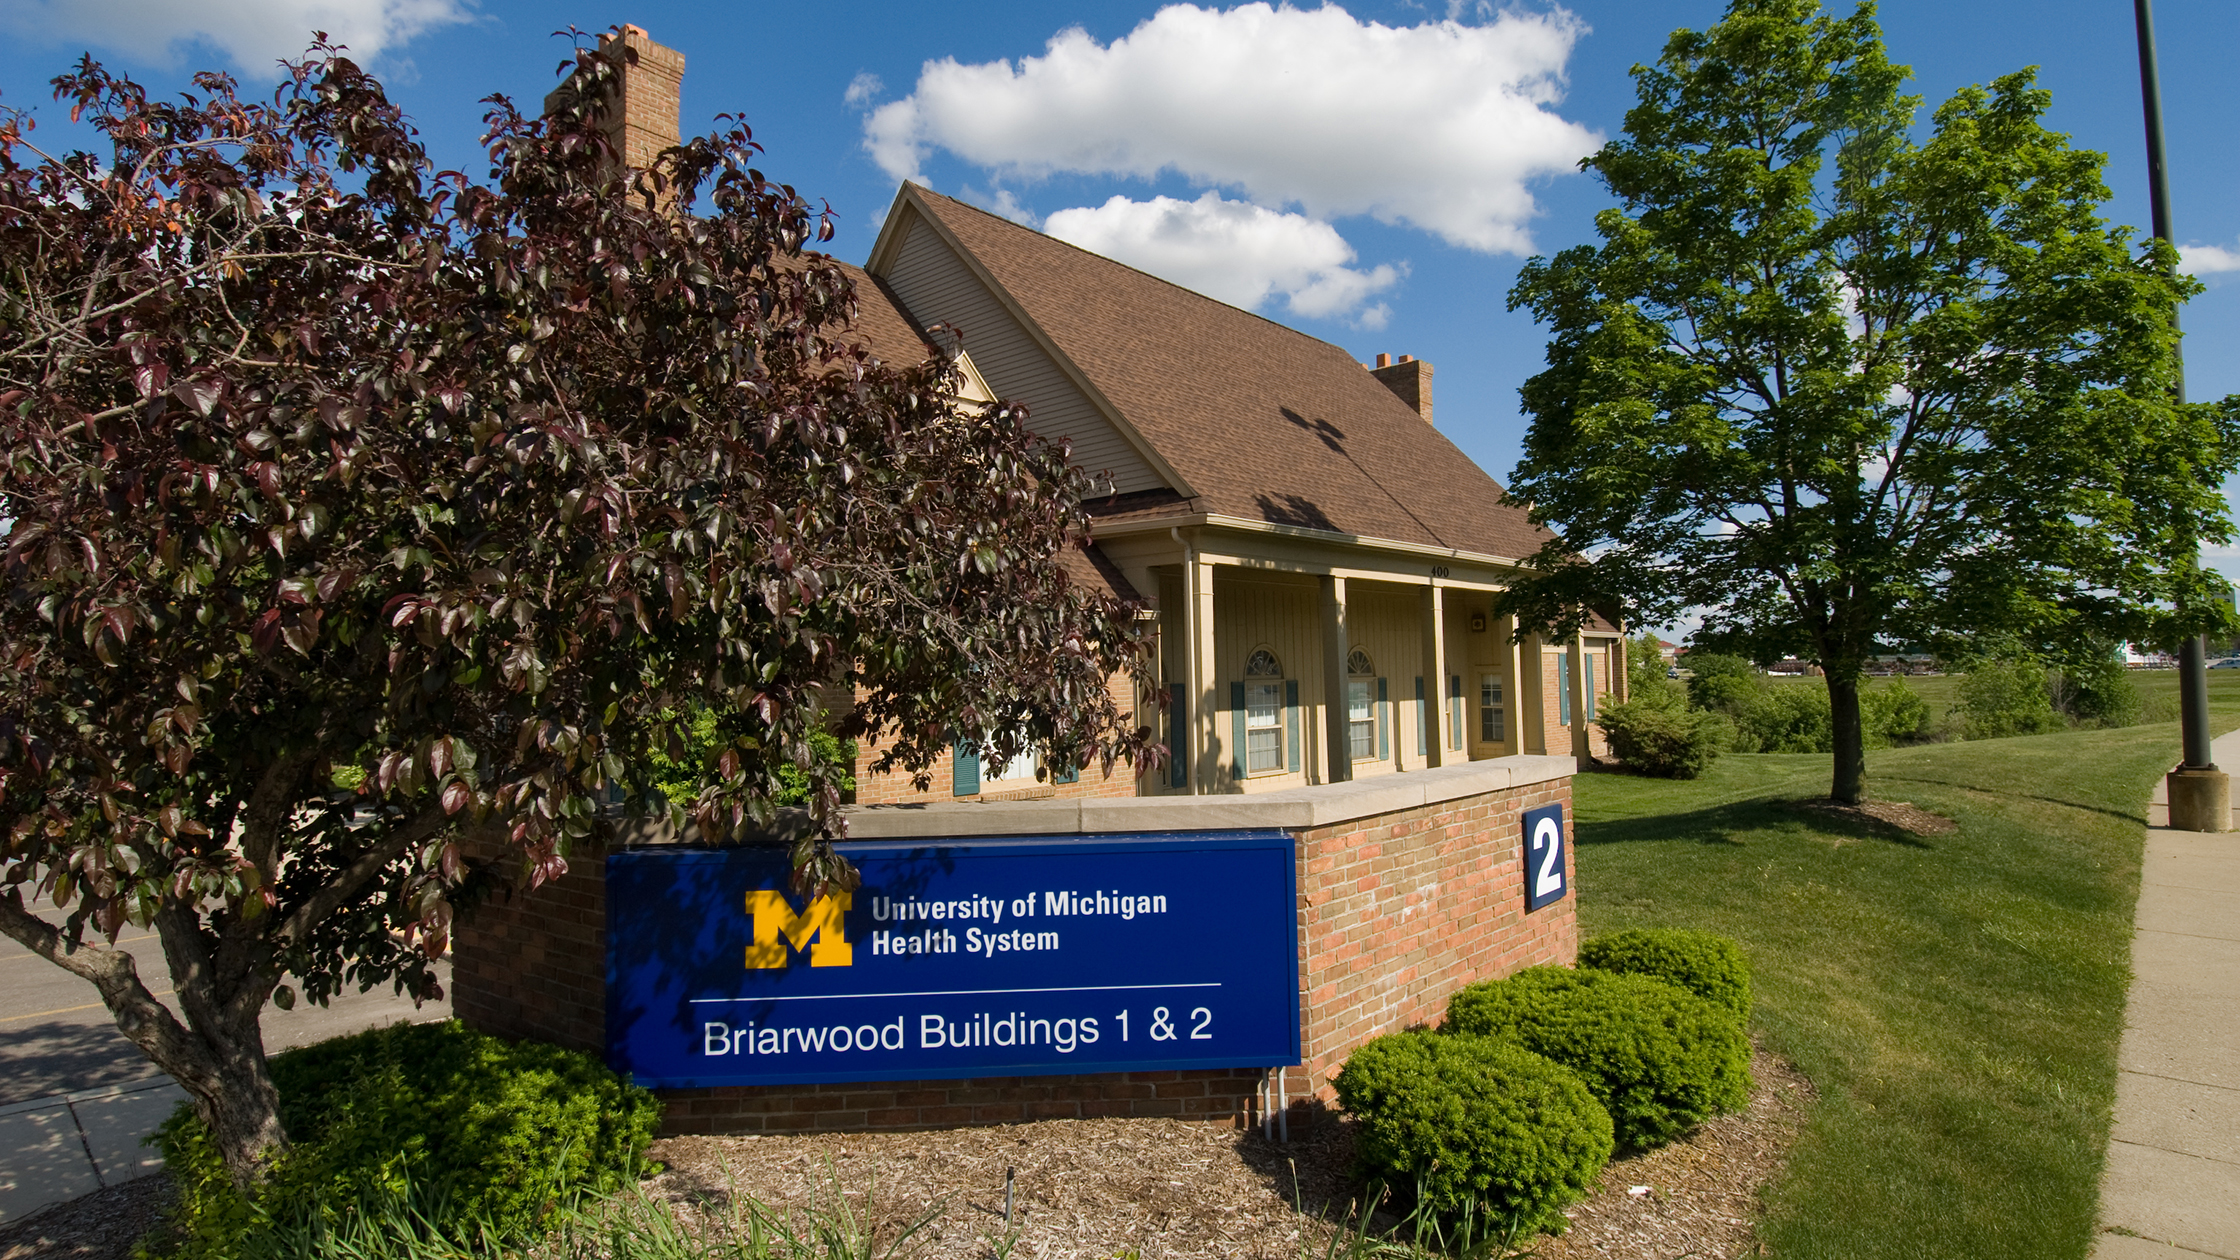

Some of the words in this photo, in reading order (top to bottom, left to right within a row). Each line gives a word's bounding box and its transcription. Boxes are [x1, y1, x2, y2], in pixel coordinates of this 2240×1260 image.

[1431, 565, 1450, 578] 400
[1533, 816, 1562, 899] 2
[872, 893, 1005, 924] University
[1011, 892, 1037, 917] of
[1045, 889, 1168, 920] Michigan
[745, 889, 853, 970] M
[872, 928, 957, 955] Health
[965, 927, 1060, 958] System
[704, 1015, 904, 1056] Briarwood
[920, 1011, 1100, 1053] Buildings
[1115, 1009, 1129, 1042] 1
[1149, 1006, 1178, 1042] &
[1190, 1007, 1213, 1040] 2
